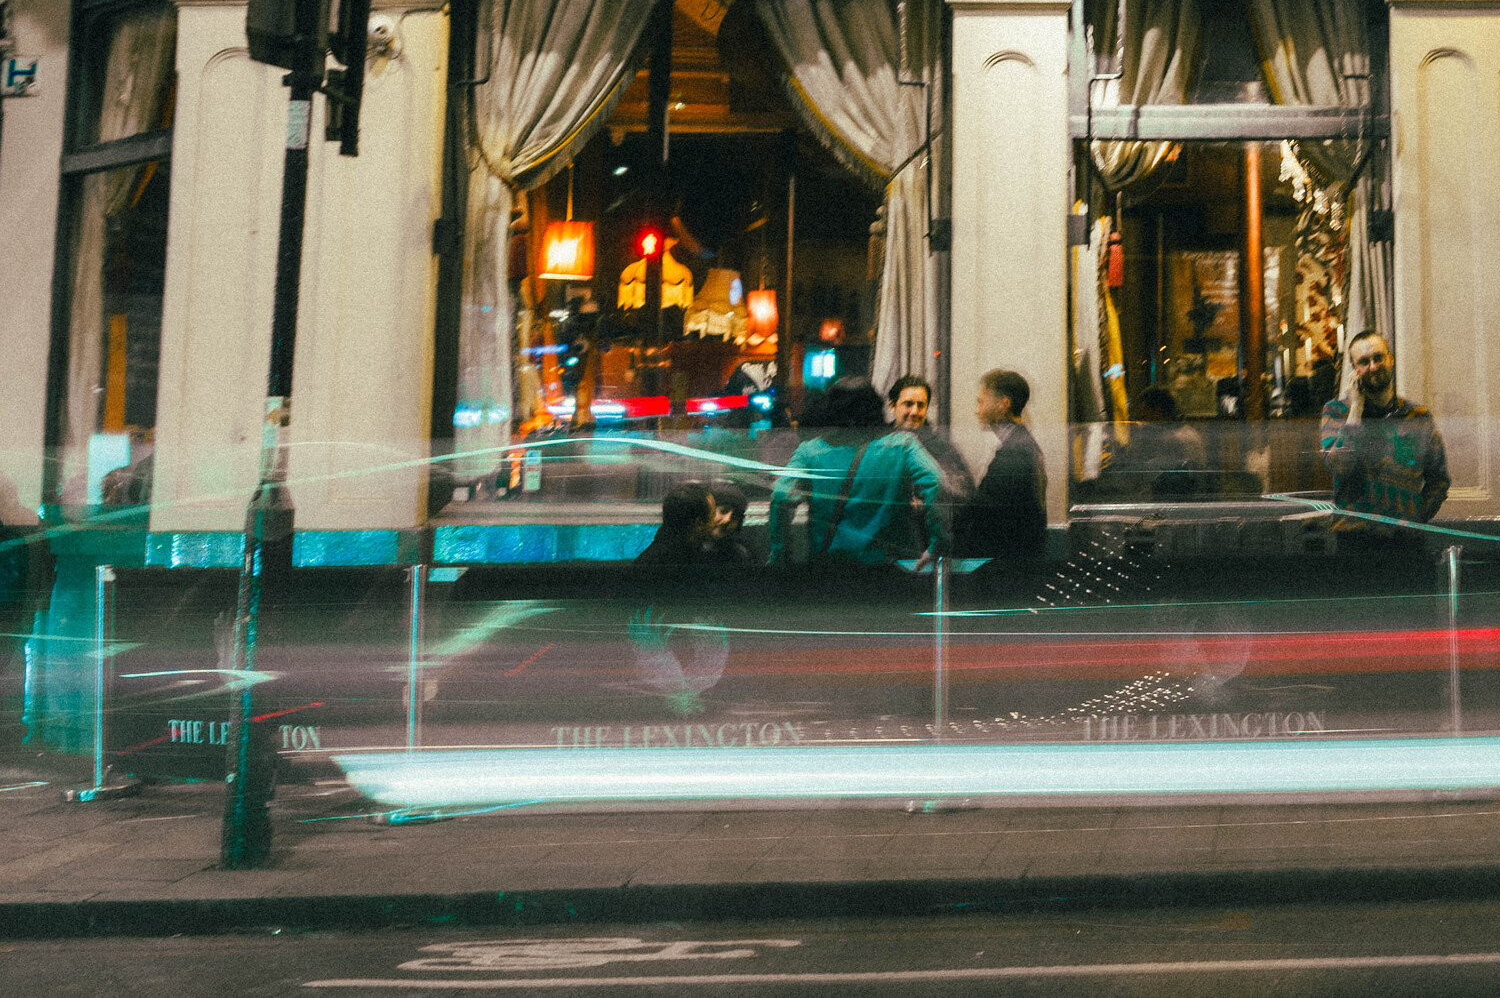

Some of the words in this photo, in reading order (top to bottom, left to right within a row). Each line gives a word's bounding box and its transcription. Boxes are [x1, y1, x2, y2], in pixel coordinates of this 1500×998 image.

[168, 718, 204, 744] THE
[551, 726, 611, 749] THE
[623, 721, 801, 748] LEXINGTON
[1150, 711, 1325, 739] LEXINGTON
